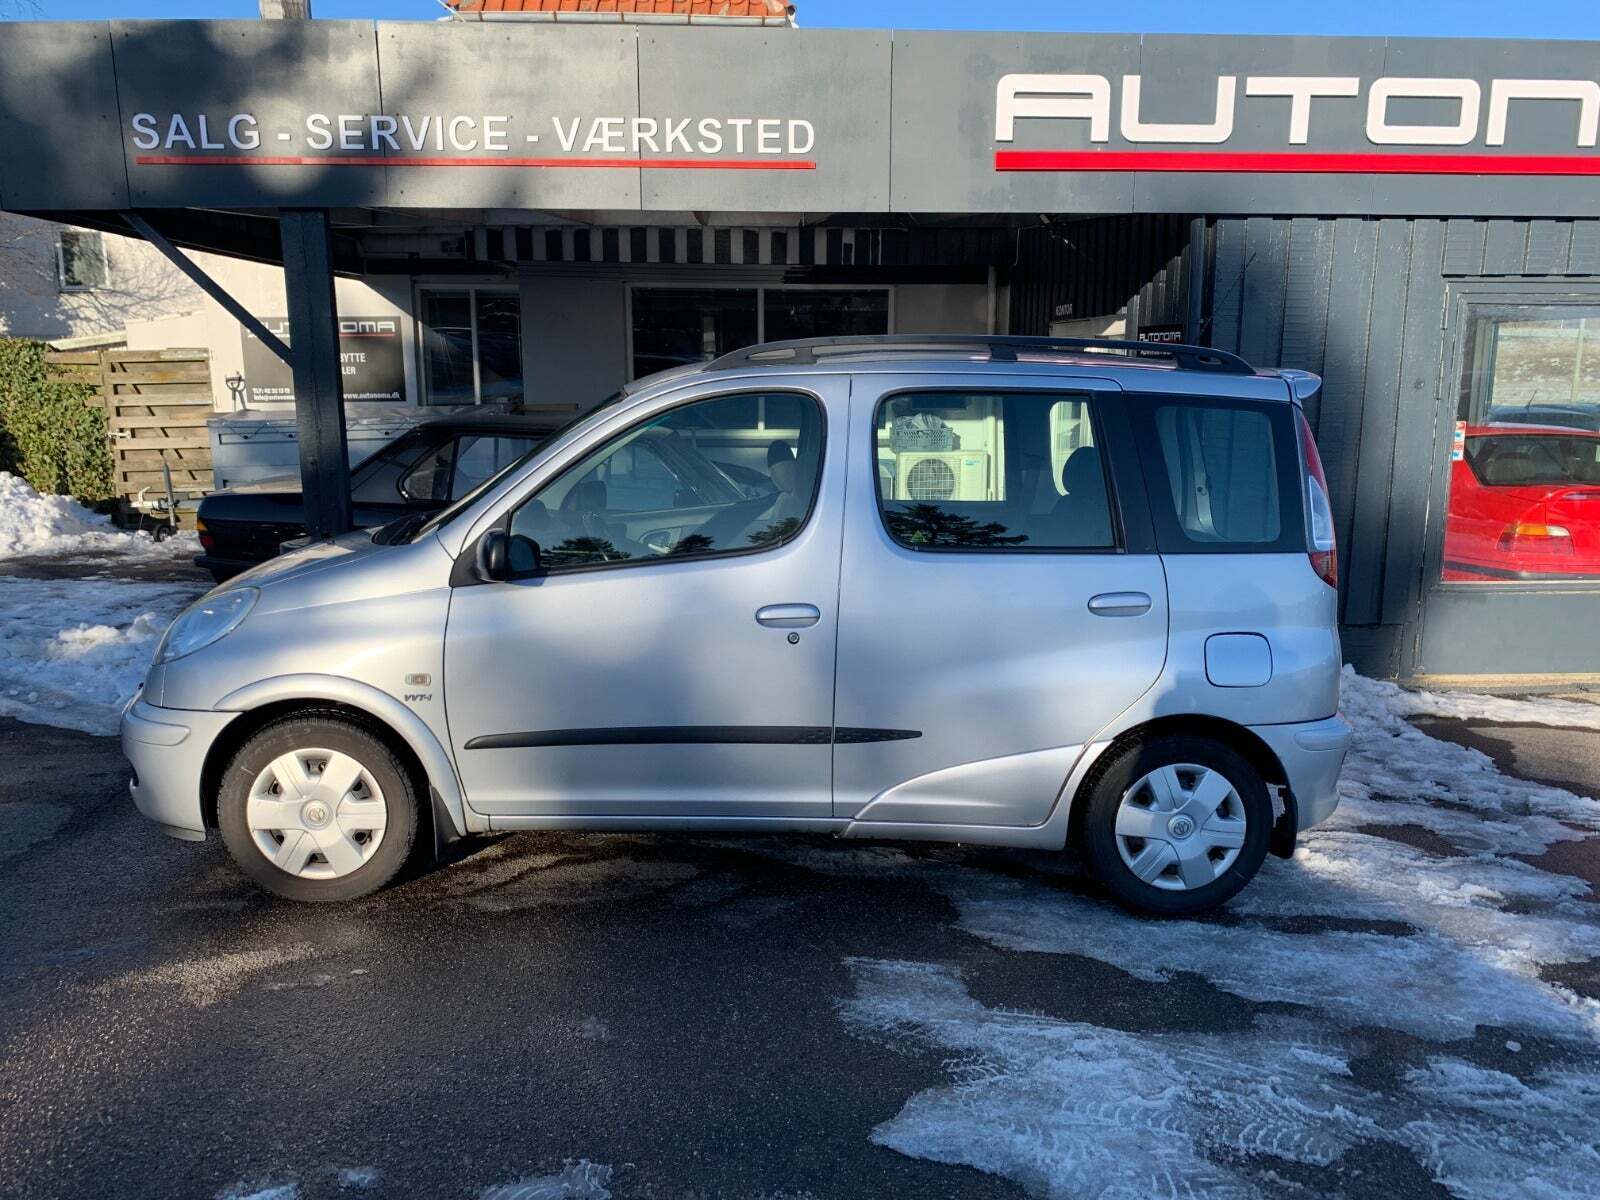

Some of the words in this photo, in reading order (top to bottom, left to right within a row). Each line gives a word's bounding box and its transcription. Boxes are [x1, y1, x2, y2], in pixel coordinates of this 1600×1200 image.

[131, 113, 261, 150] SALG
[306, 113, 509, 152] SERVICE
[552, 116, 816, 154] VÆRKSTED
[995, 73, 1600, 147] AUTON
